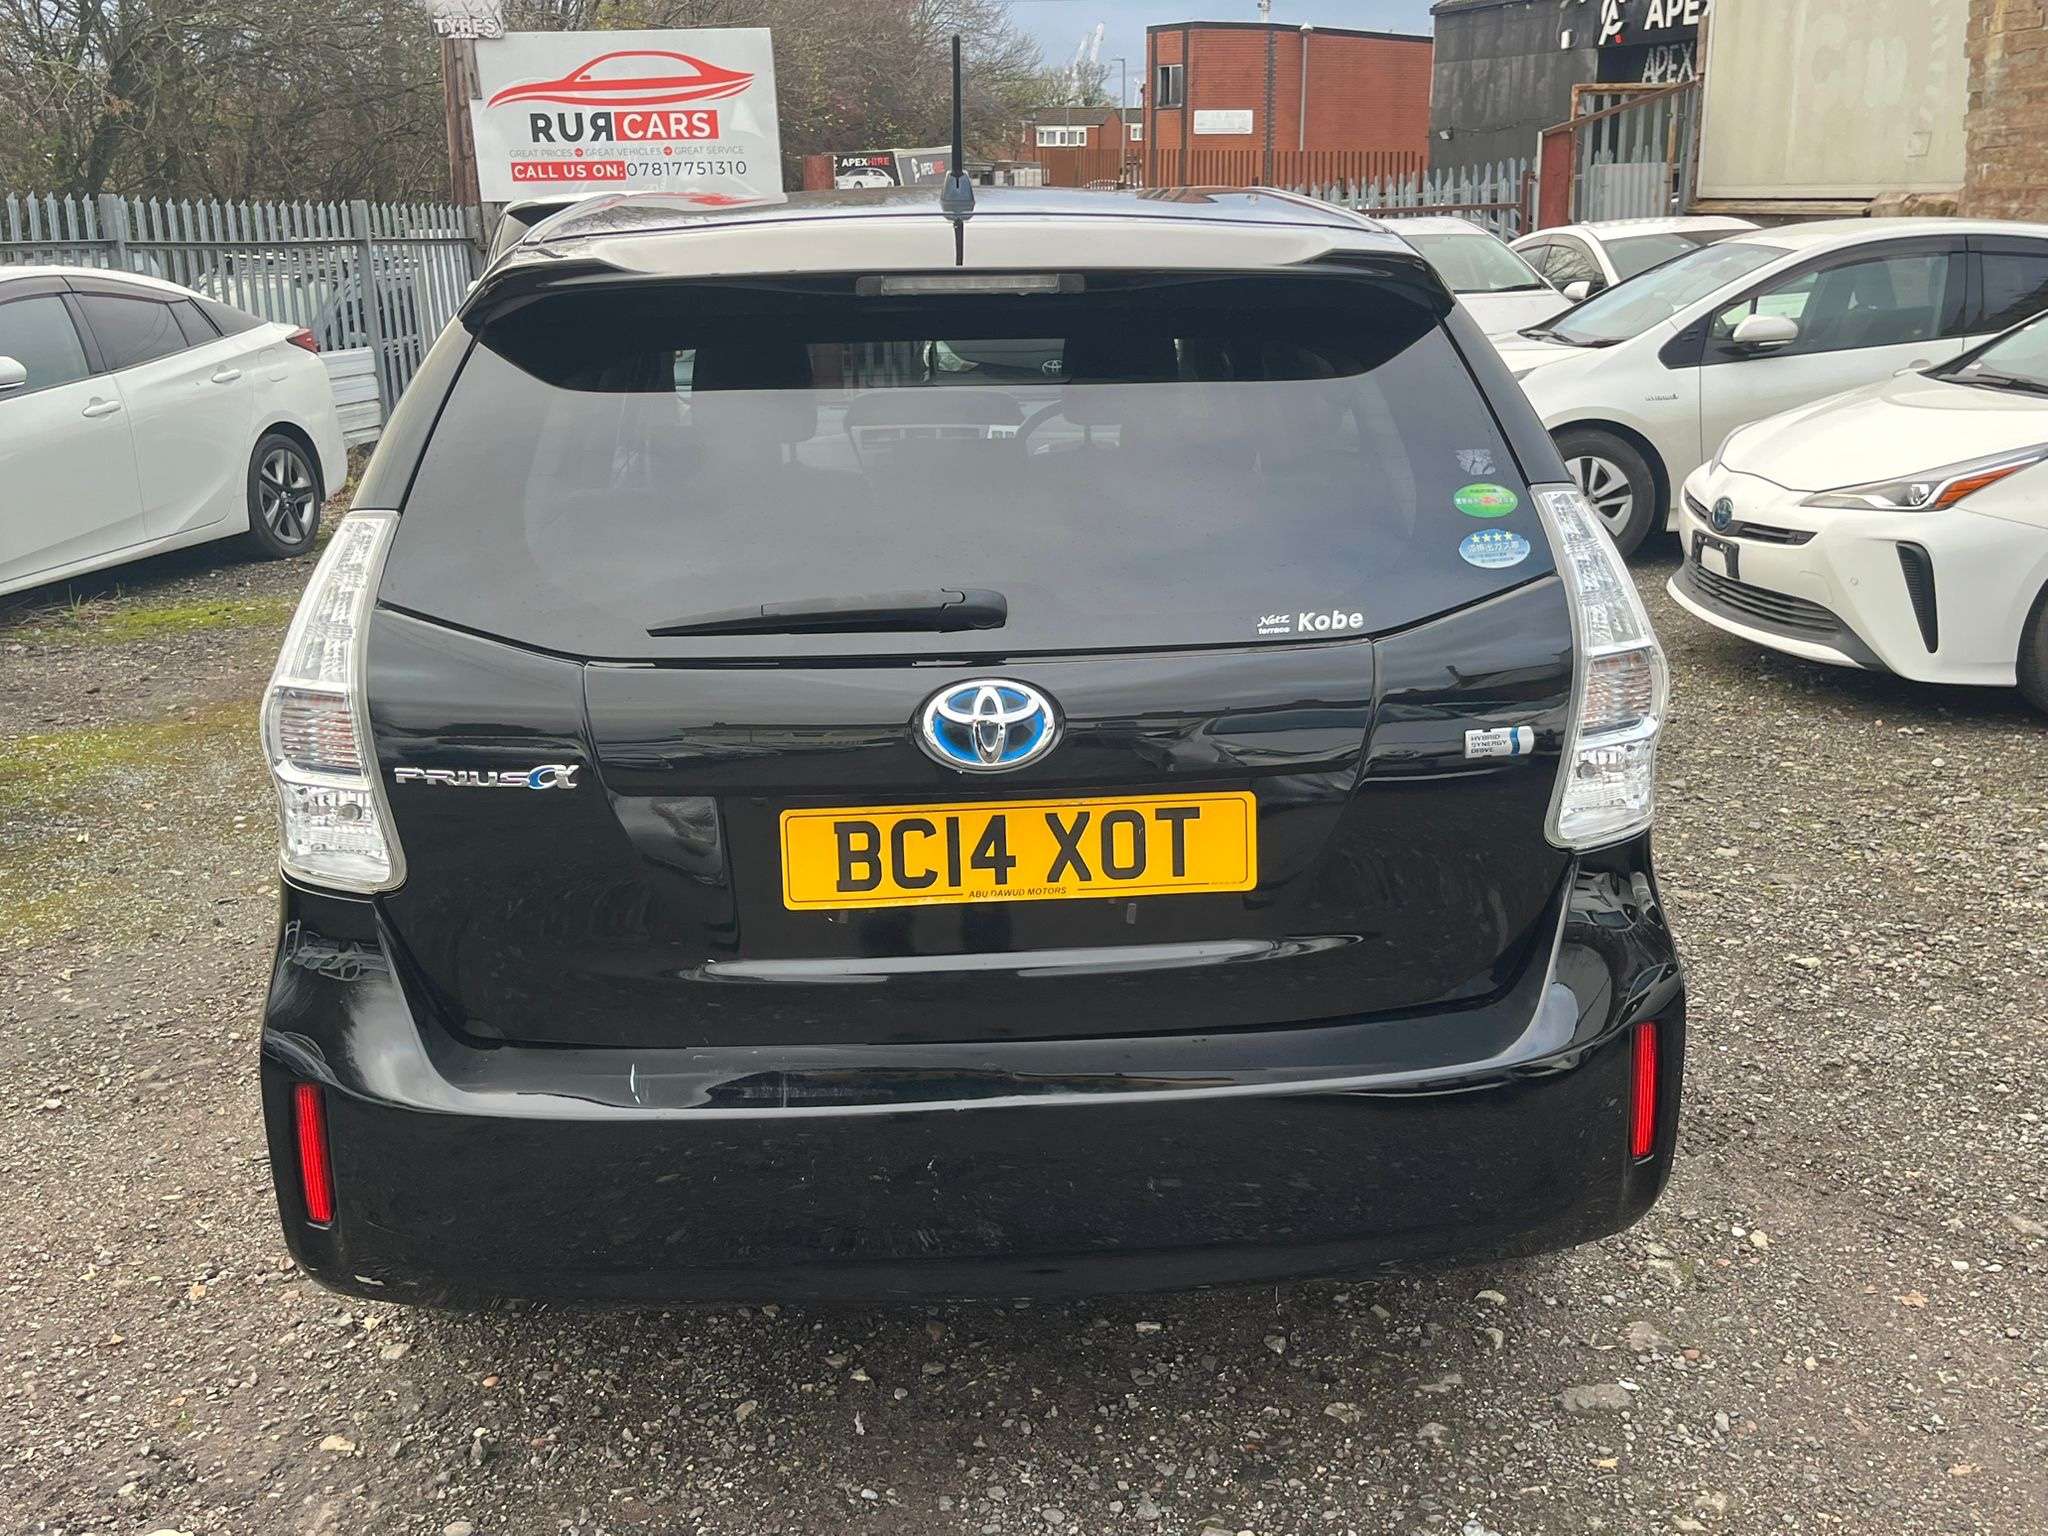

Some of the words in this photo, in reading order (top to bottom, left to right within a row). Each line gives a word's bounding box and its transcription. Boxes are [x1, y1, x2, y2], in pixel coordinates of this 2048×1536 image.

[433, 18, 496, 33] TYRES
[1641, 41, 1696, 84] APEX
[509, 149, 539, 159] GREAT
[541, 148, 573, 157] PRICES
[585, 148, 616, 158] GREAT
[618, 147, 662, 157] VEHICLES
[674, 146, 704, 156] GREAT
[706, 145, 745, 155] SERVICE
[513, 164, 559, 180] CALL
[563, 164, 587, 178] US
[592, 163, 624, 177] ON:
[626, 160, 748, 177] 07817751310
[1298, 609, 1364, 632] Kobe
[1471, 740, 1507, 748] SYNERGY
[832, 814, 1017, 893] BC14
[1045, 806, 1201, 883] XOT
[968, 889, 988, 898] ABU
[991, 888, 1025, 897] DAWUD
[1027, 887, 1067, 896] MOTORS
